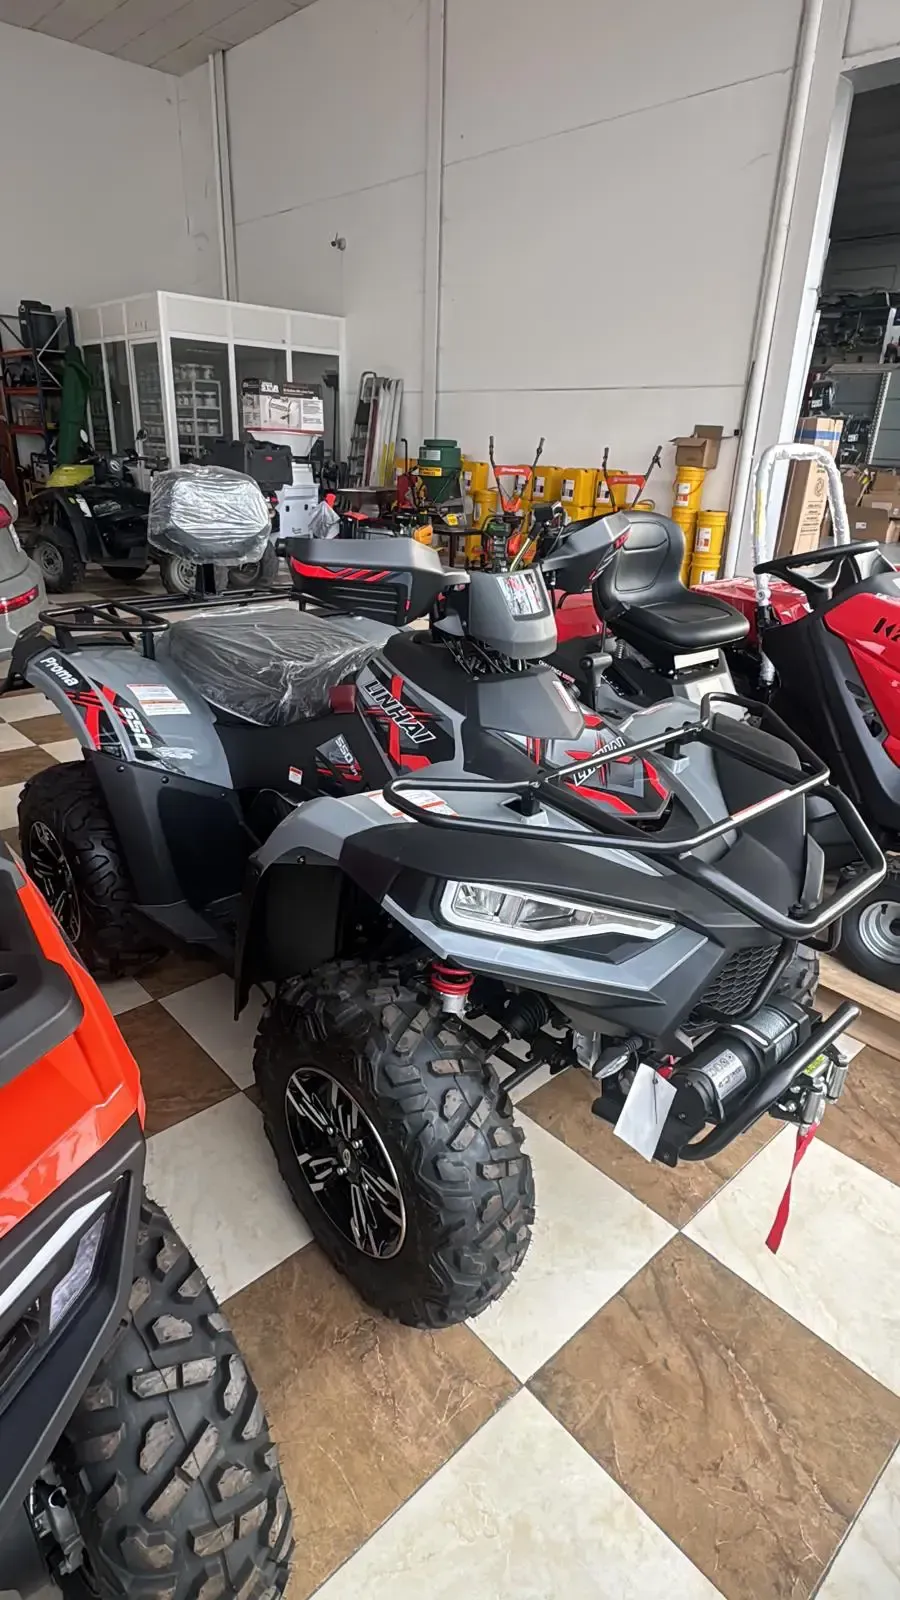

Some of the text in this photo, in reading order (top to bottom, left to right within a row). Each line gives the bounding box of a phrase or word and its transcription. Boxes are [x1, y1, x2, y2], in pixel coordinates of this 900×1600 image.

[39, 657, 79, 686] Proma
[119, 707, 152, 748] 550
[364, 681, 437, 744] LINHAI
[335, 736, 354, 764] 550
